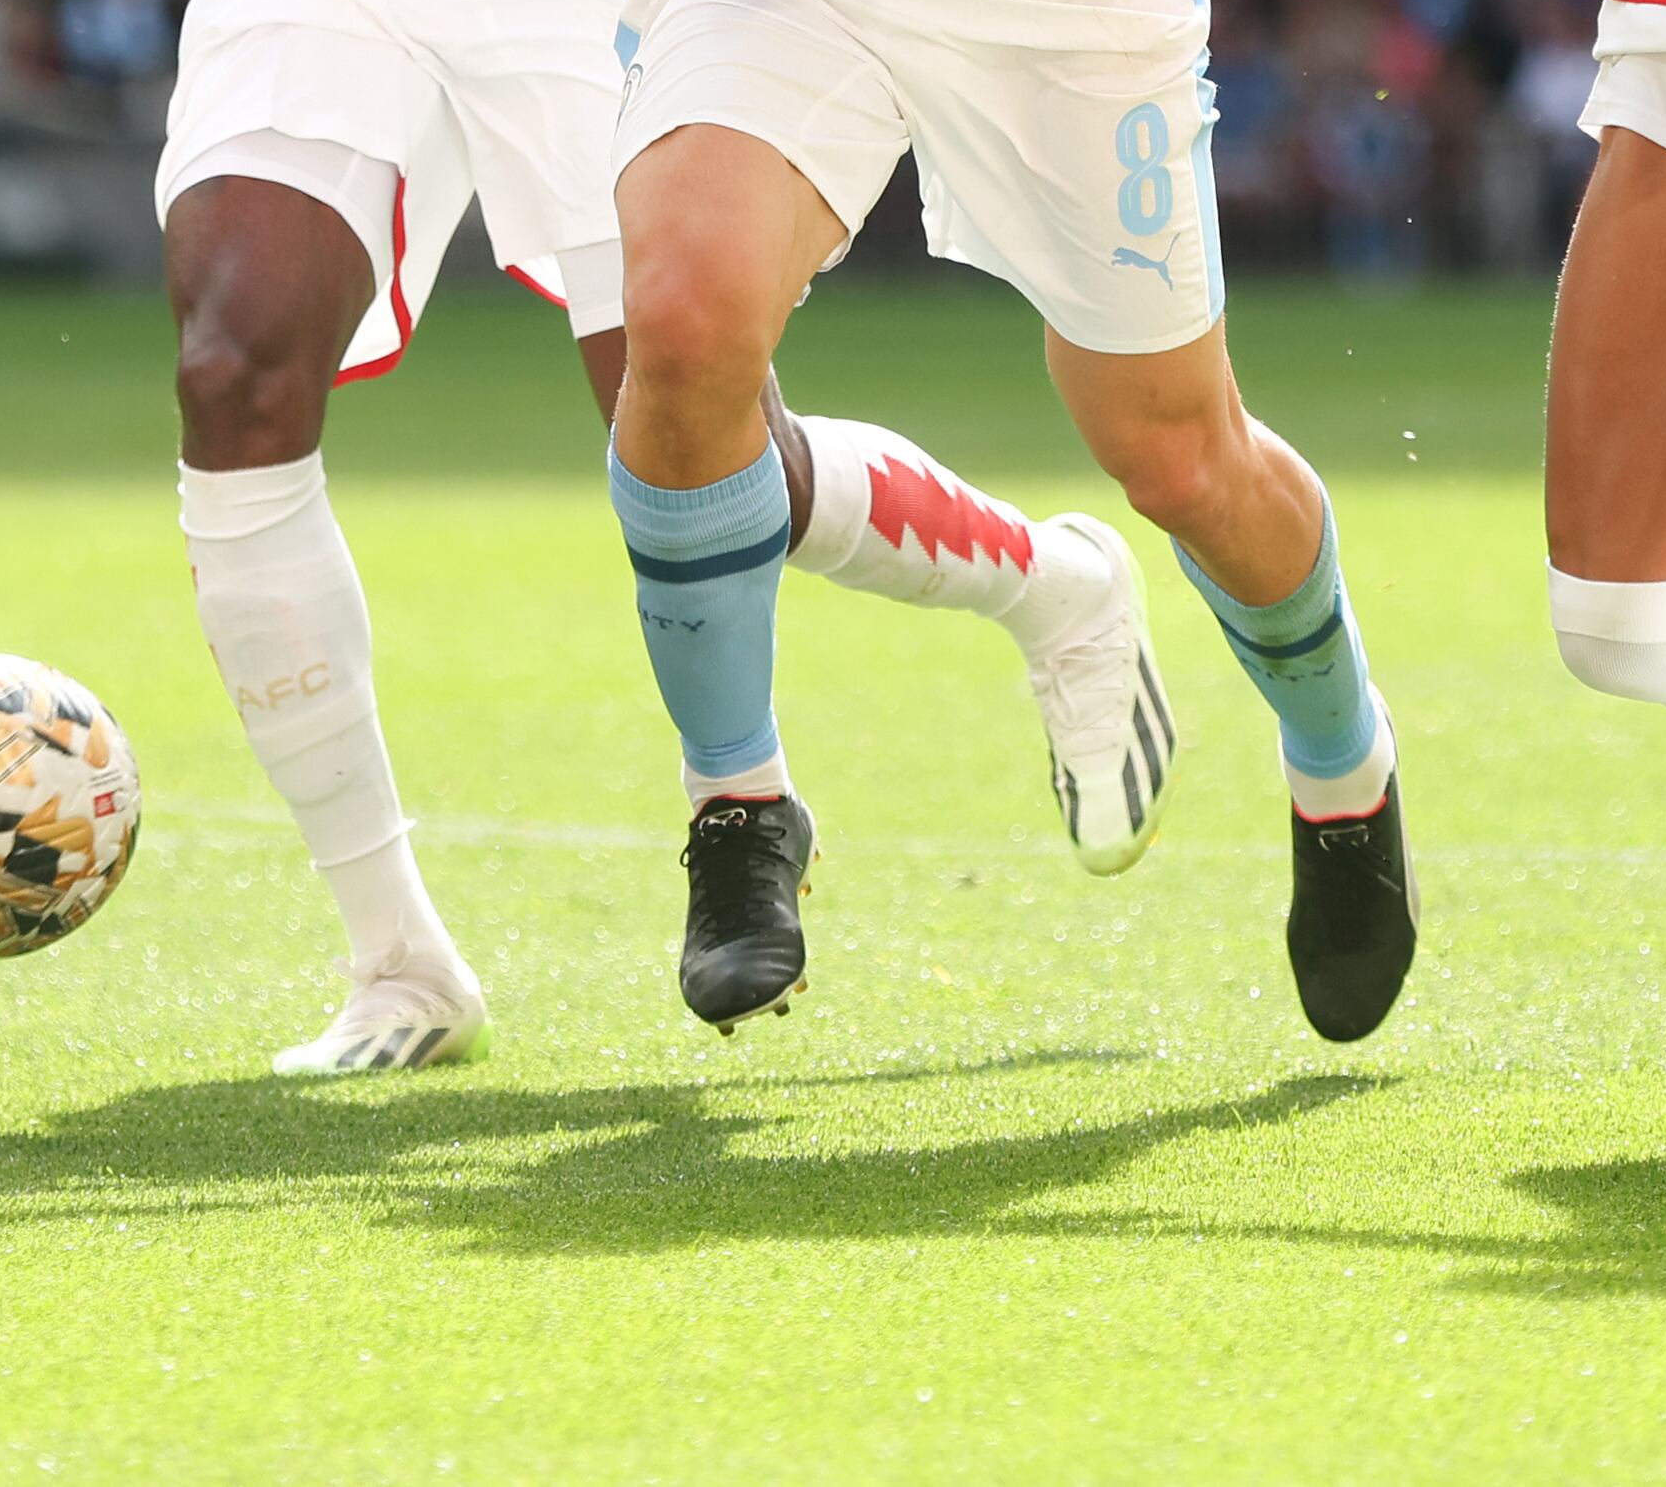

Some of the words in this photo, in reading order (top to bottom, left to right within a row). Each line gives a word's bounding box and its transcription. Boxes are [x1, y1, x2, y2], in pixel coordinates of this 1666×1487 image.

[1114, 101, 1174, 237] 8
[643, 609, 706, 633] ITY
[237, 662, 330, 712] AFC
